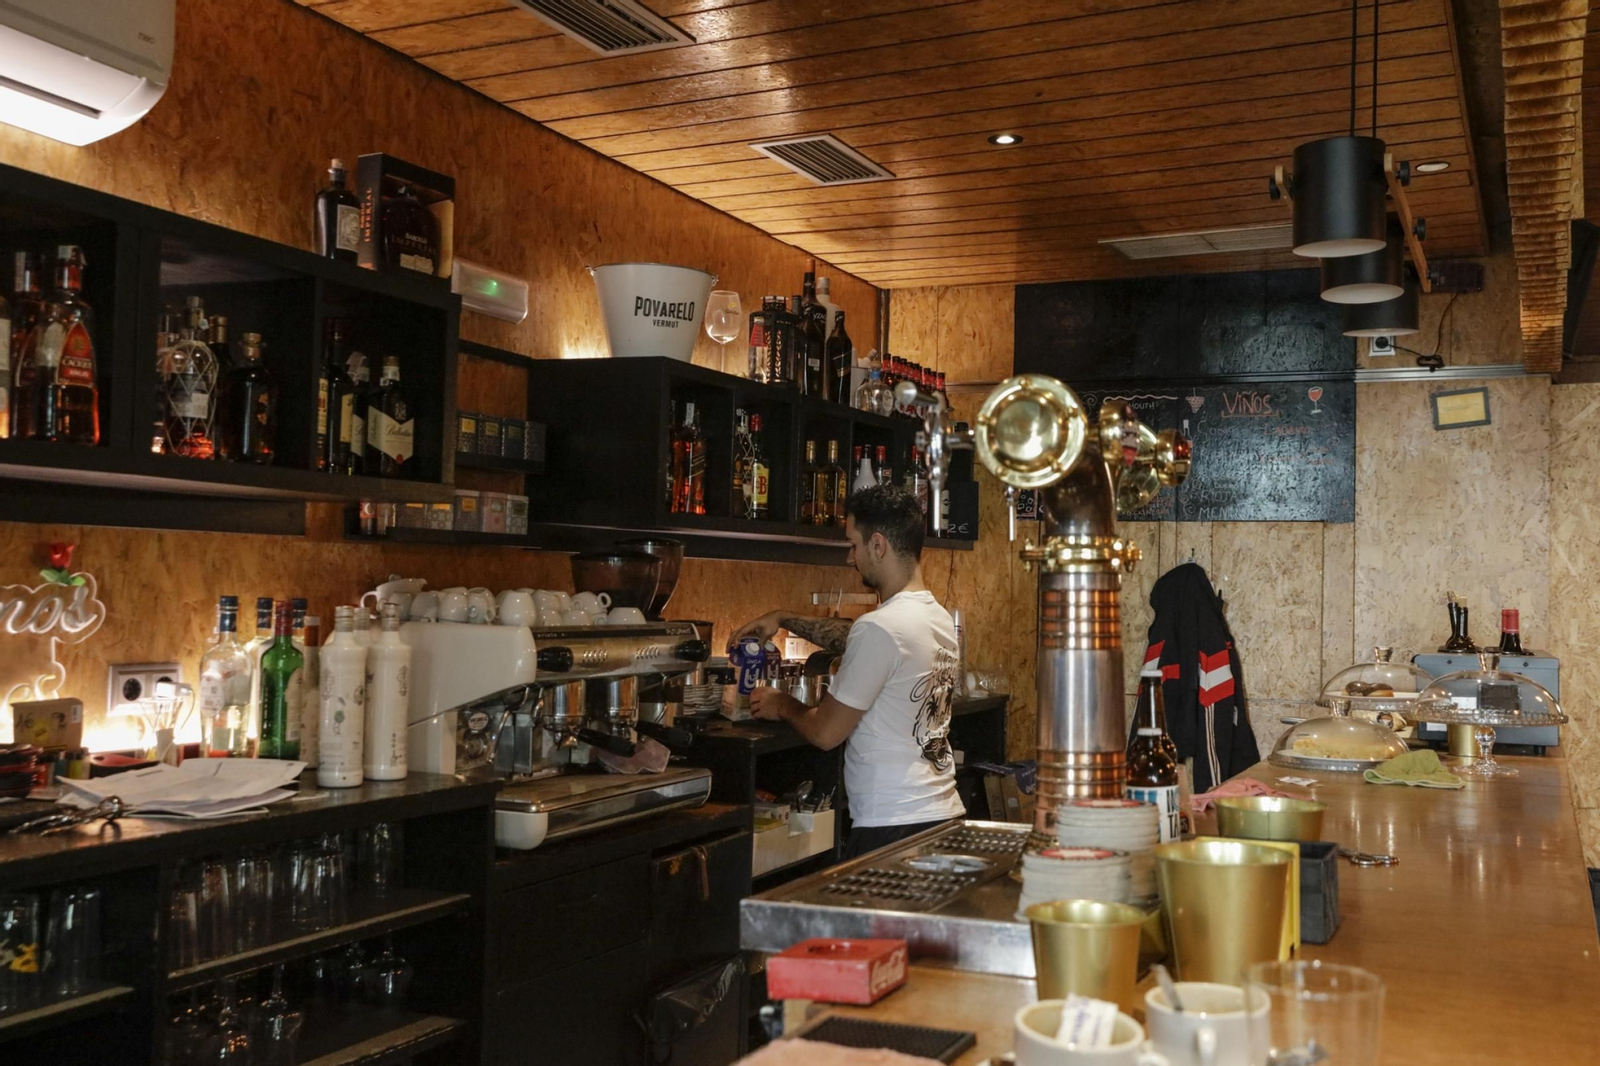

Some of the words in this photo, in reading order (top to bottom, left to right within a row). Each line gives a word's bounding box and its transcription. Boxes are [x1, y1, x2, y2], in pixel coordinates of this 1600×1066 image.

[634, 296, 696, 322] POVARELO
[652, 319, 680, 329] VERMUT
[1222, 391, 1274, 415] VIÑOS
